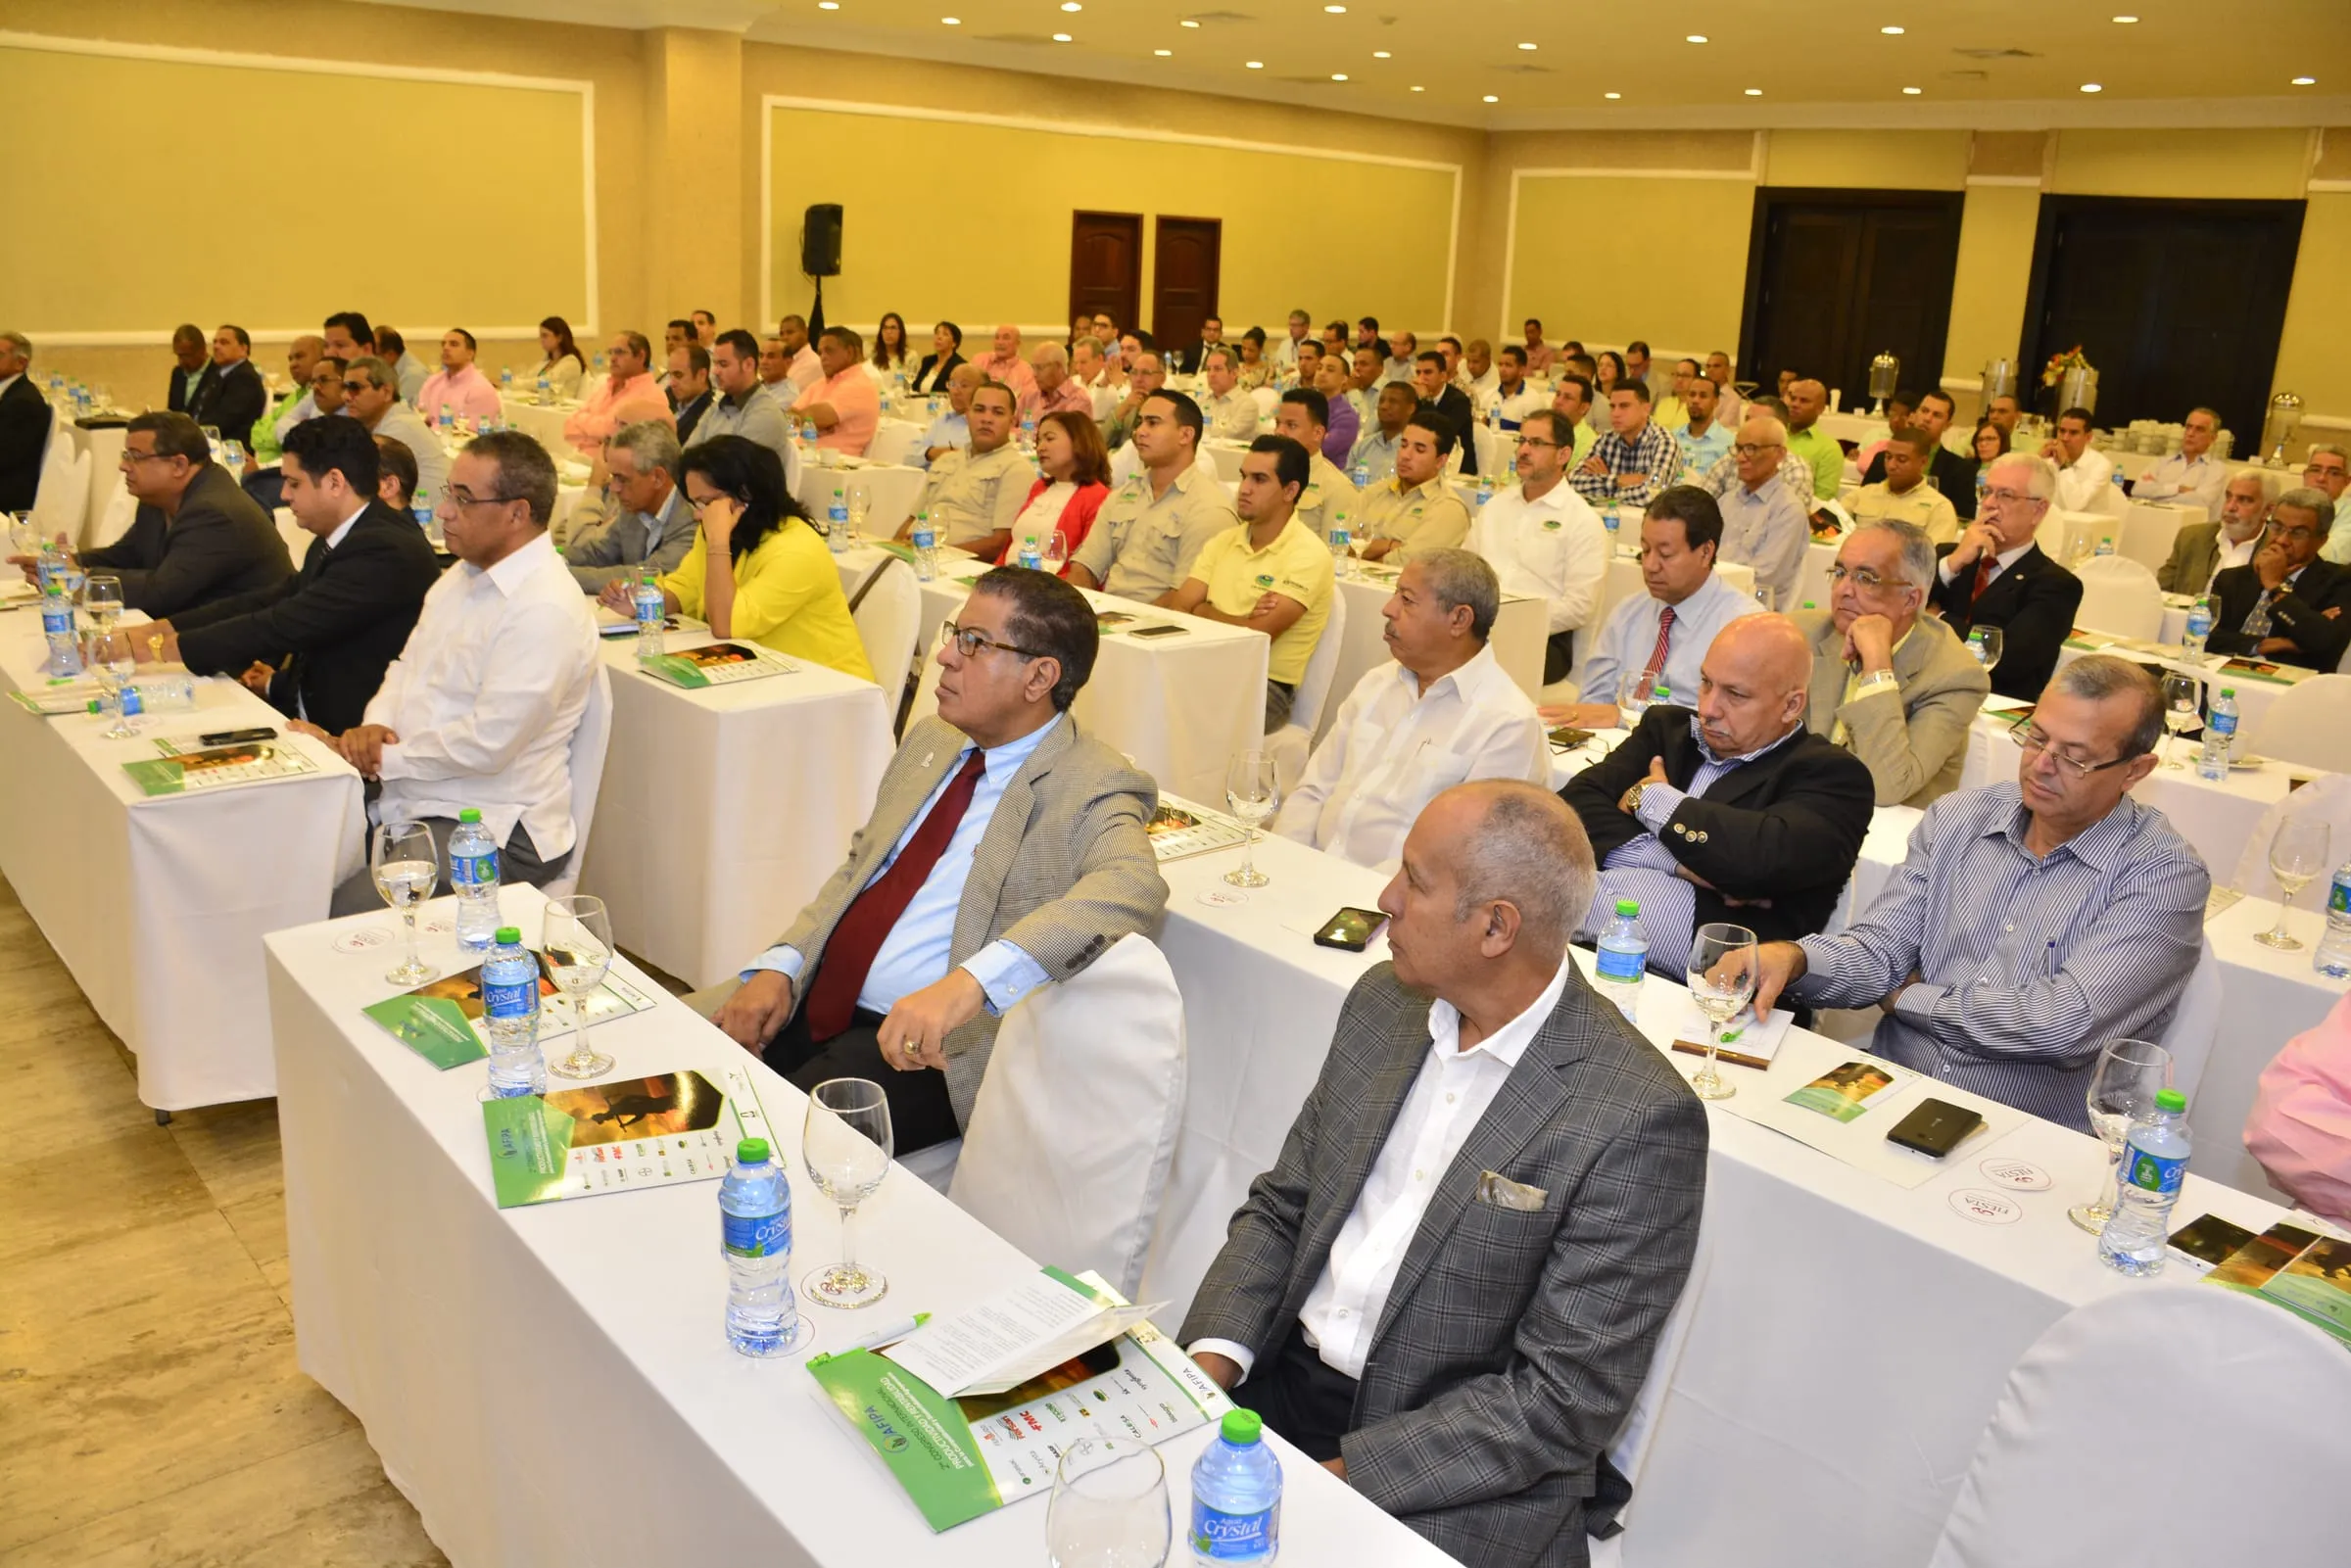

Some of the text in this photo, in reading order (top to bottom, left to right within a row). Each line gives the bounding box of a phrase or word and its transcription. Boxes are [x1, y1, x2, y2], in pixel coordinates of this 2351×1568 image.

[486, 986, 521, 1003] Crystal
[1964, 1197, 2009, 1214] FIESTA
[1183, 1367, 1206, 1391] AFIPA
[880, 1377, 917, 1413] RENTABILIDAD
[876, 1387, 912, 1428] INTERNACIONAL
[865, 1405, 896, 1435] AFIPA
[1020, 1409, 1042, 1432] FMC
[1121, 1415, 1141, 1439] CALESA
[911, 1428, 941, 1460] CONGRESO
[917, 1417, 964, 1469] PRODUCTIVIDAD
[1204, 1515, 1263, 1538] Crystal
